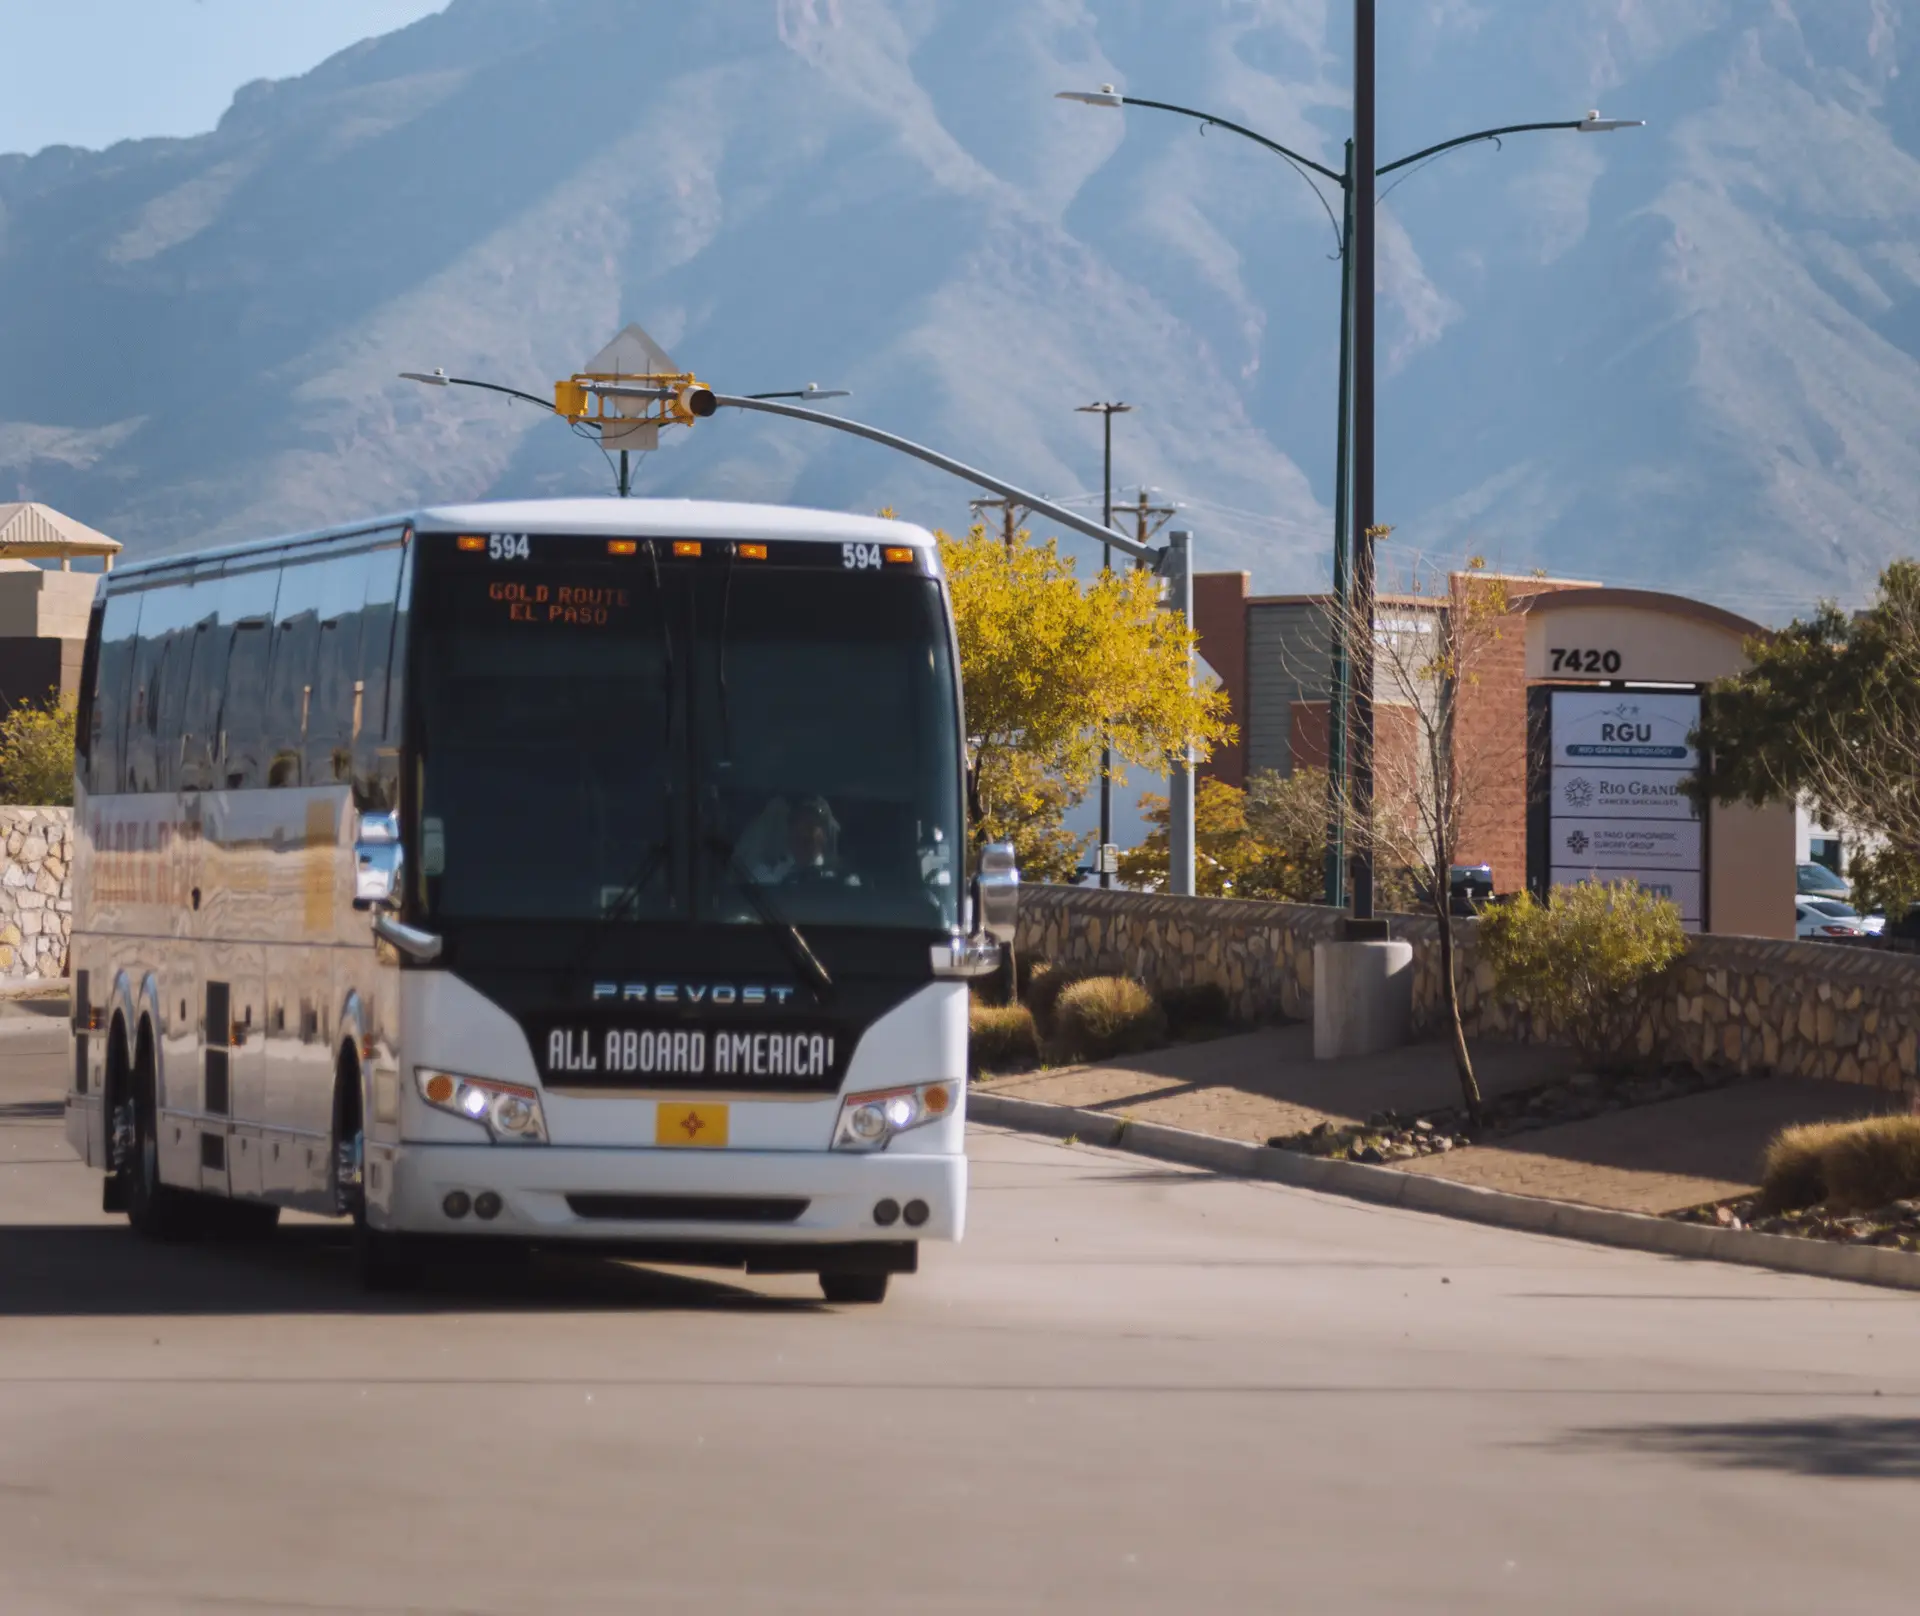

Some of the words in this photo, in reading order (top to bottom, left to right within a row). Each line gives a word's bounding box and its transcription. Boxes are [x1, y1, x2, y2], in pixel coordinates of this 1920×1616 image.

[488, 534, 530, 560] 594
[842, 543, 882, 570] 594
[488, 582, 549, 603] GOLD
[558, 586, 630, 607] ROUTE
[509, 603, 538, 622] EL
[548, 605, 608, 625] PASO
[1550, 649, 1621, 673] 7420
[1601, 723, 1651, 742] RGU
[1628, 781, 1678, 796] GRAND
[593, 982, 794, 1004] PREVOST
[549, 1029, 597, 1070] ALL
[605, 1031, 705, 1074] ABOARD
